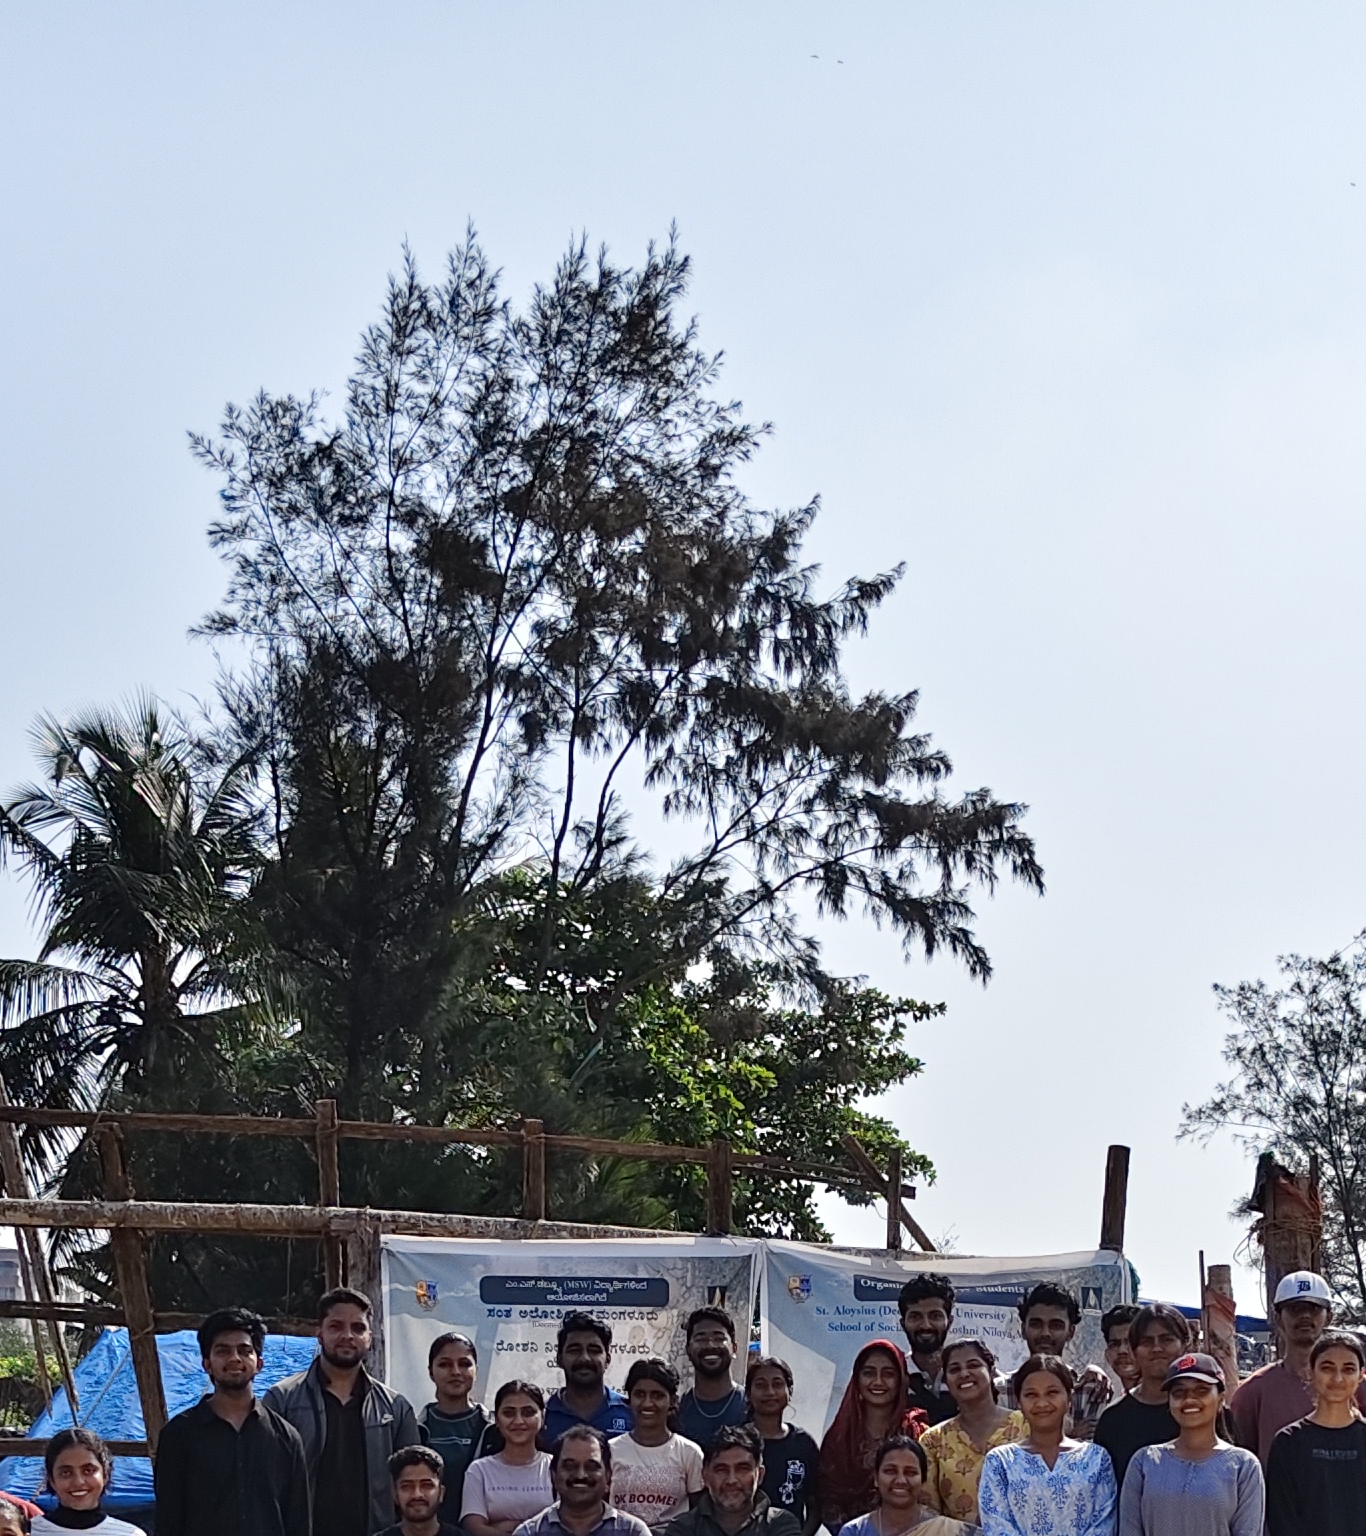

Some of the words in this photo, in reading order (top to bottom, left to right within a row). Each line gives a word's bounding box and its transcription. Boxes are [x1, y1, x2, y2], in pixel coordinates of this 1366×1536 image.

[563, 1280, 592, 1291] (MSW)
[486, 1306, 513, 1319] ಸಂತ
[815, 1305, 830, 1316] St.
[833, 1305, 876, 1318] Aloysius
[955, 1308, 1006, 1322] University
[827, 1321, 862, 1332] School
[864, 1321, 876, 1332] of
[948, 1325, 979, 1337] oshni
